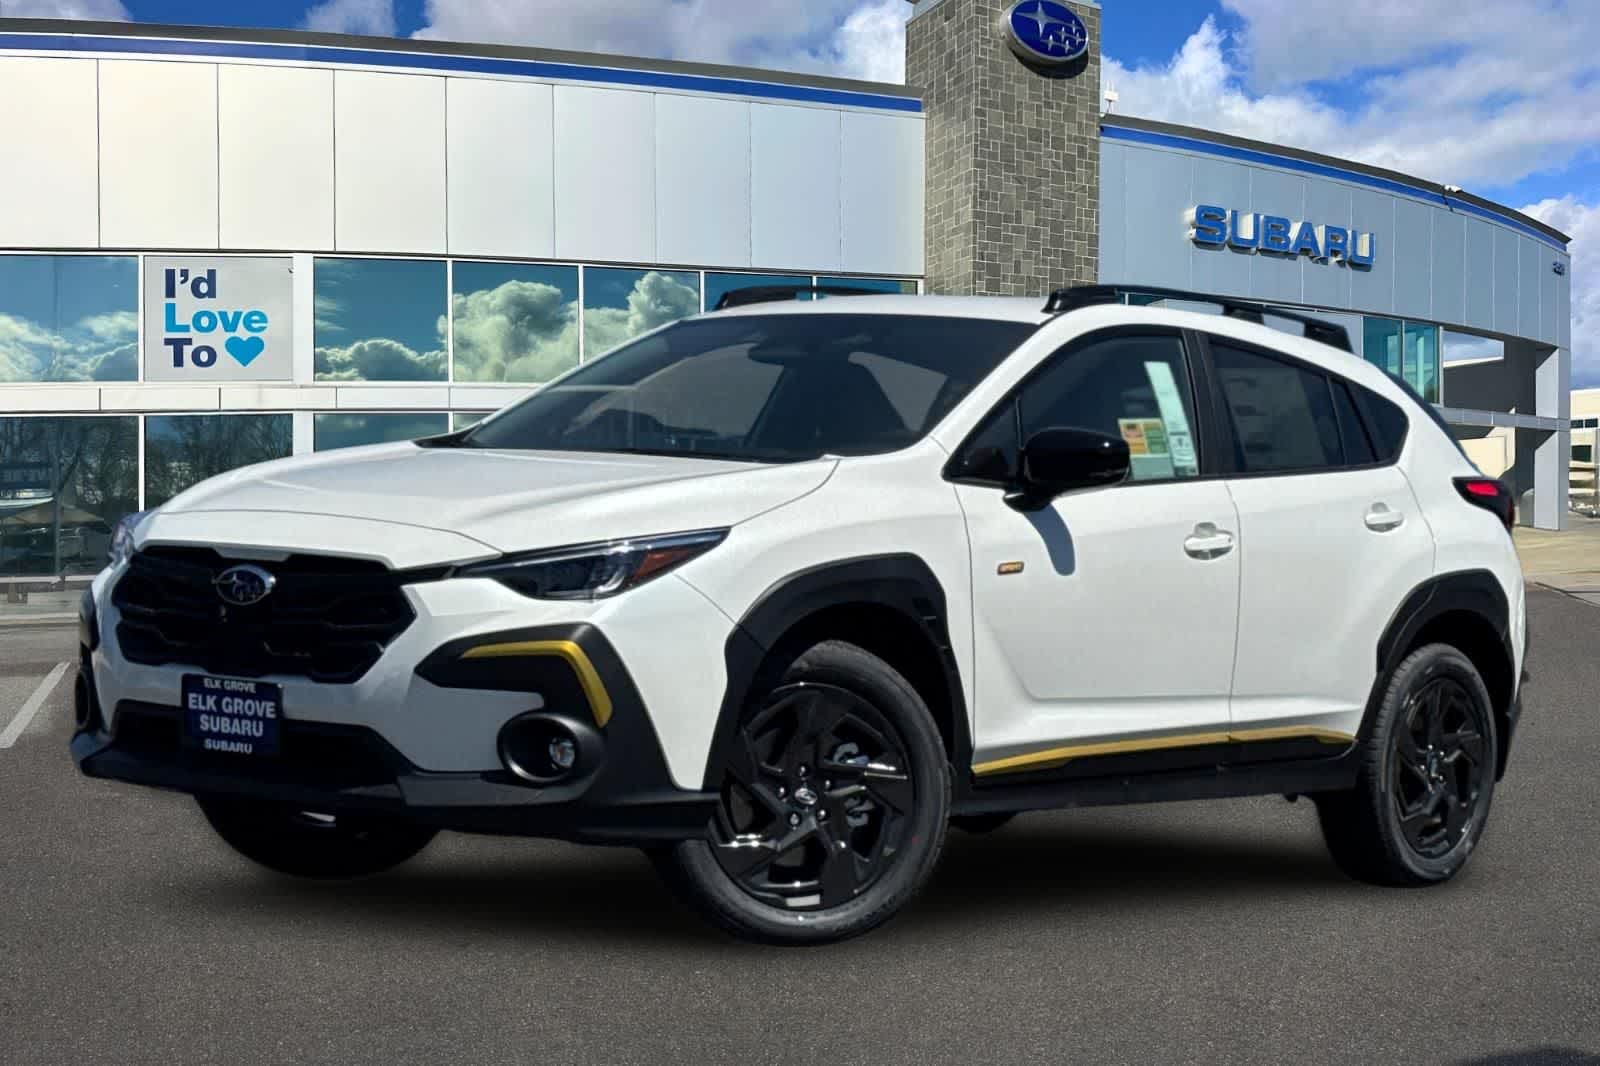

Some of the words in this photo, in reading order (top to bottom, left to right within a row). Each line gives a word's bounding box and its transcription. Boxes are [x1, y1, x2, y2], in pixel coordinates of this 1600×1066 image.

[1192, 204, 1376, 268] SUBARU
[165, 269, 217, 299] I’d
[165, 303, 268, 333] Love
[164, 338, 217, 368] To
[203, 678, 221, 688] ELK
[223, 680, 256, 693] GROVE
[188, 693, 217, 712] ELK
[221, 696, 276, 718] GROVE
[200, 714, 263, 737] SUBARU
[204, 738, 253, 754] SUBARU
